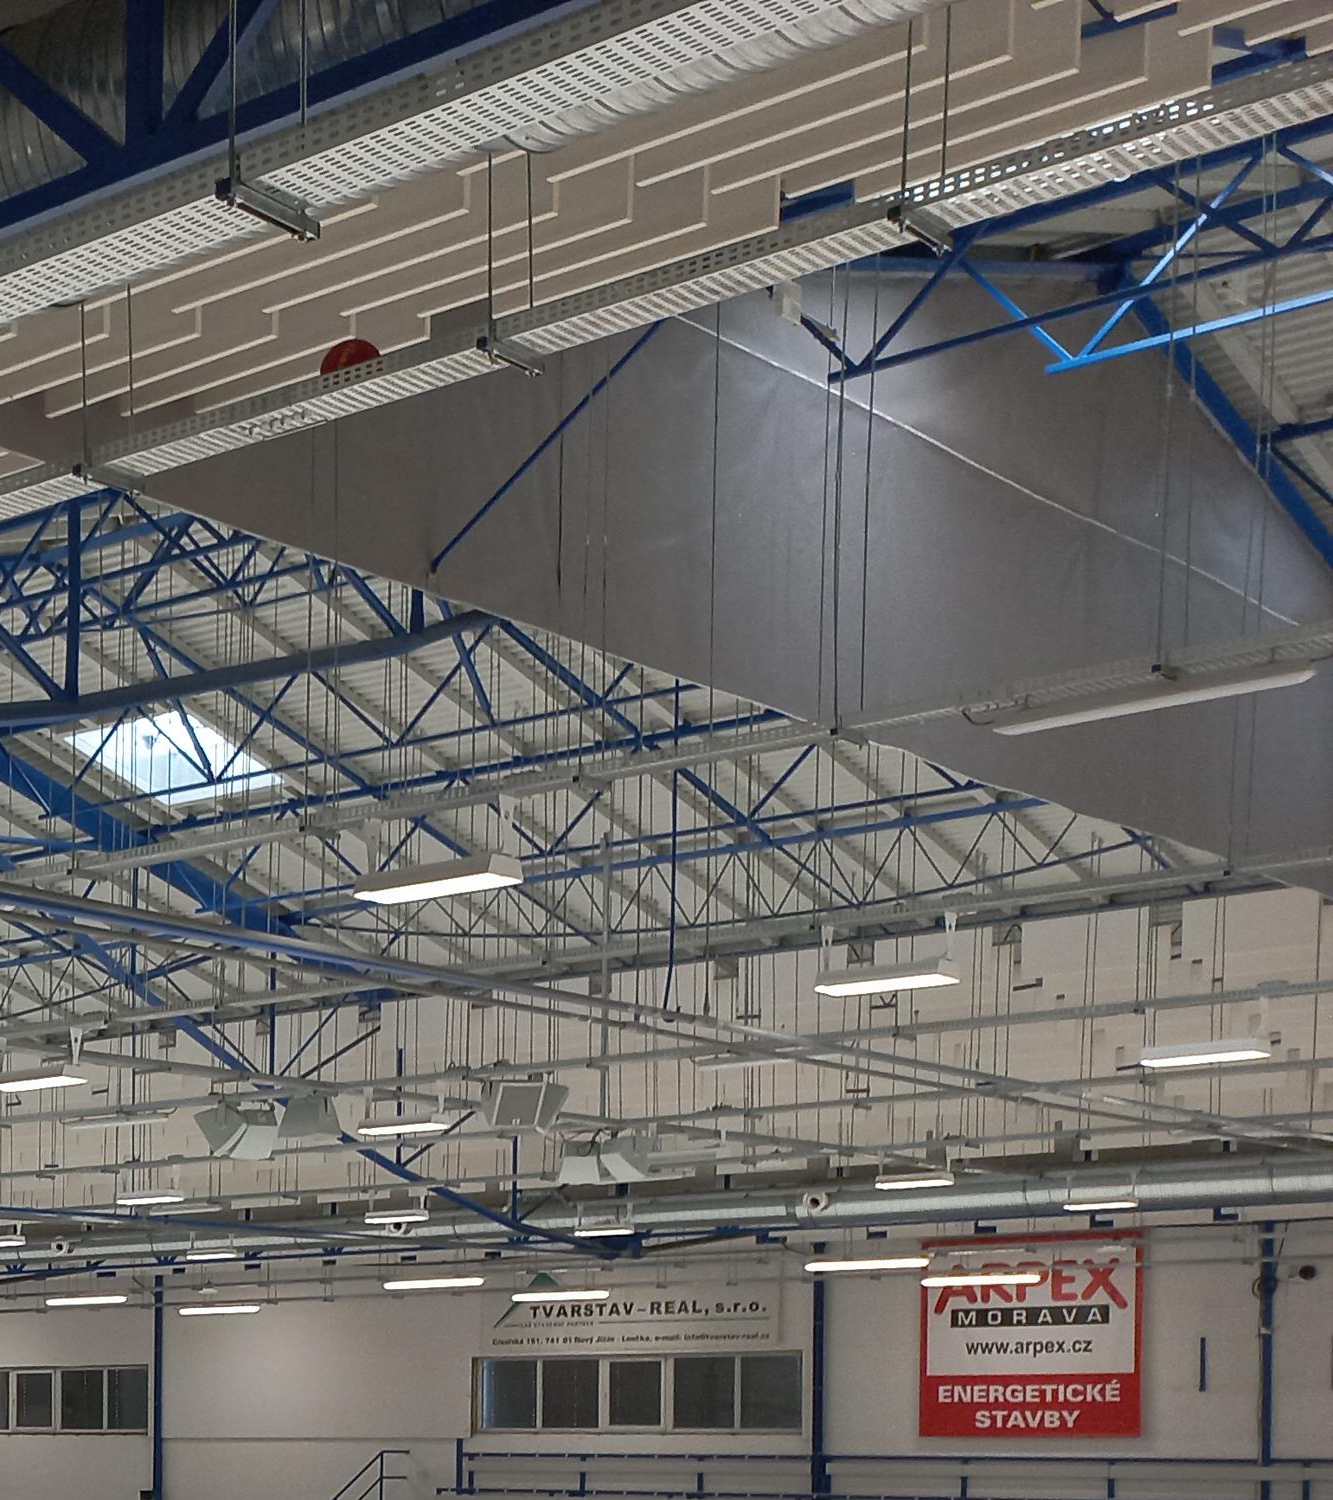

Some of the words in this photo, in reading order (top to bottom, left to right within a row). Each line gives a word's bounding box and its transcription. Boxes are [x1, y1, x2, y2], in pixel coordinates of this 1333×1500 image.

[934, 1257, 1129, 1315] ARPEX
[715, 1301, 767, 1315] s.r.o.
[957, 1307, 1103, 1326] MORAVA
[965, 1338, 1093, 1358] www.arpex.cz
[937, 1379, 1121, 1404] ENERGETICKÉ
[974, 1409, 1081, 1430] STAVBY
